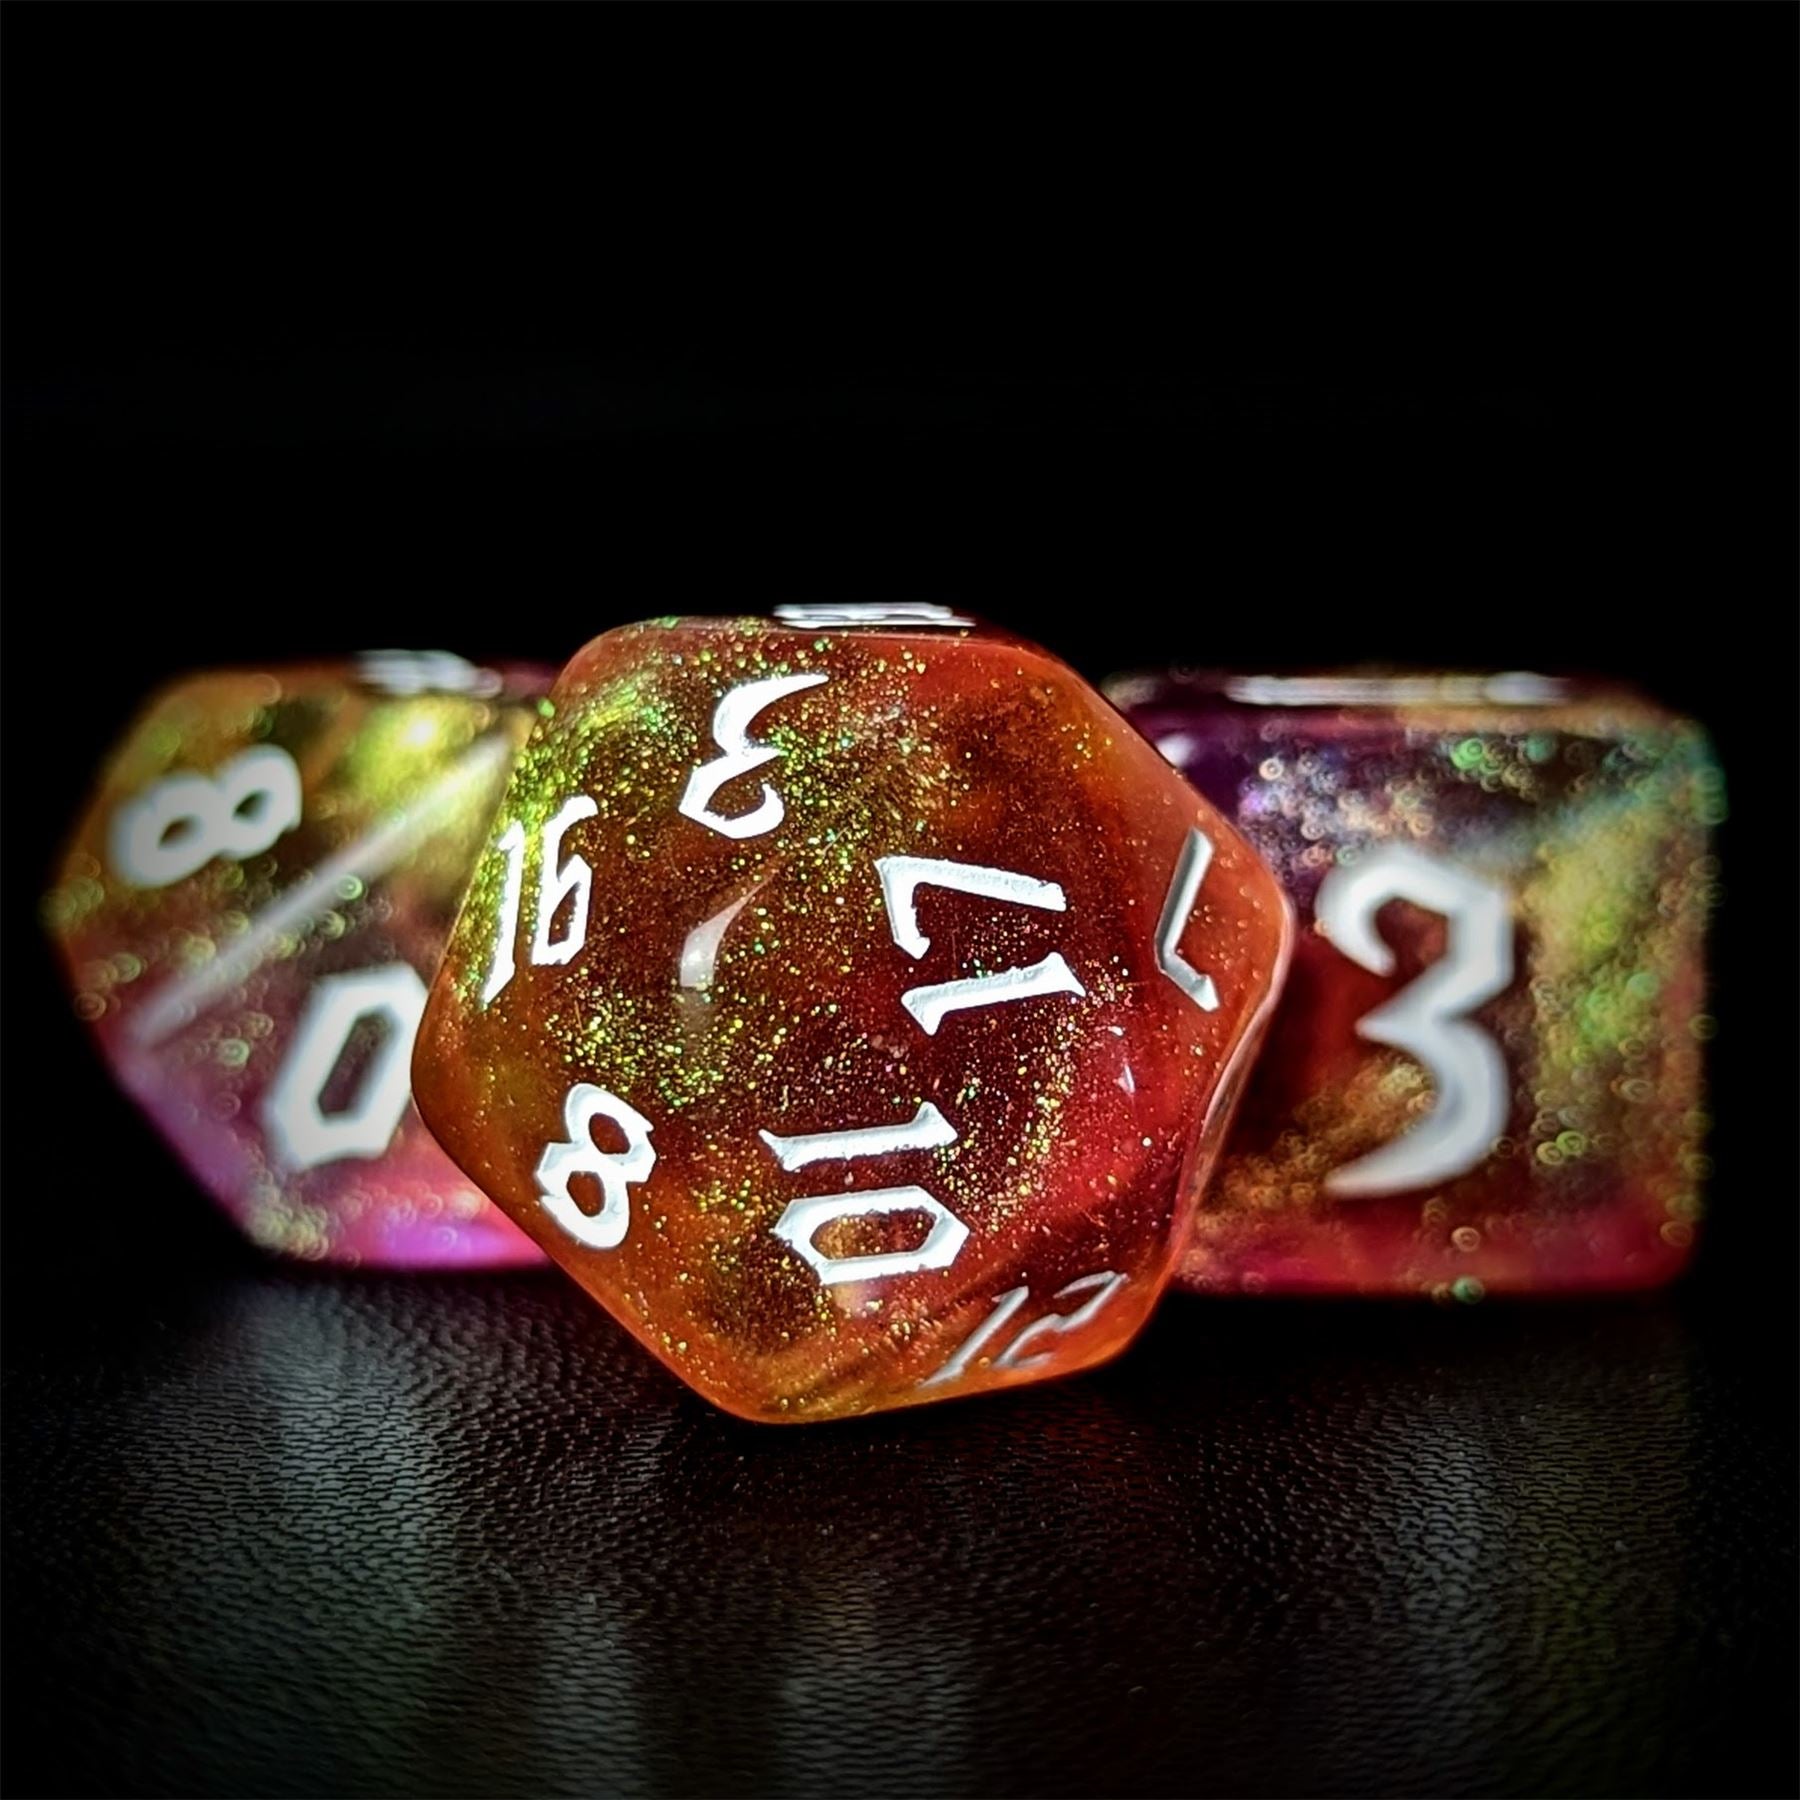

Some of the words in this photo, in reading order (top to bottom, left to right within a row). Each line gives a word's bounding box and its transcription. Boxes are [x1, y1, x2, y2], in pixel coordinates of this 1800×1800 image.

[110, 743, 302, 886] 8
[679, 671, 830, 840] 3
[482, 795, 599, 1006] 16
[854, 854, 1087, 1037] 17
[263, 963, 429, 1170] 0
[1314, 842, 1516, 1197] 3
[534, 1082, 658, 1250] 8
[757, 1100, 971, 1286] 10
[916, 1269, 1130, 1389] 12
